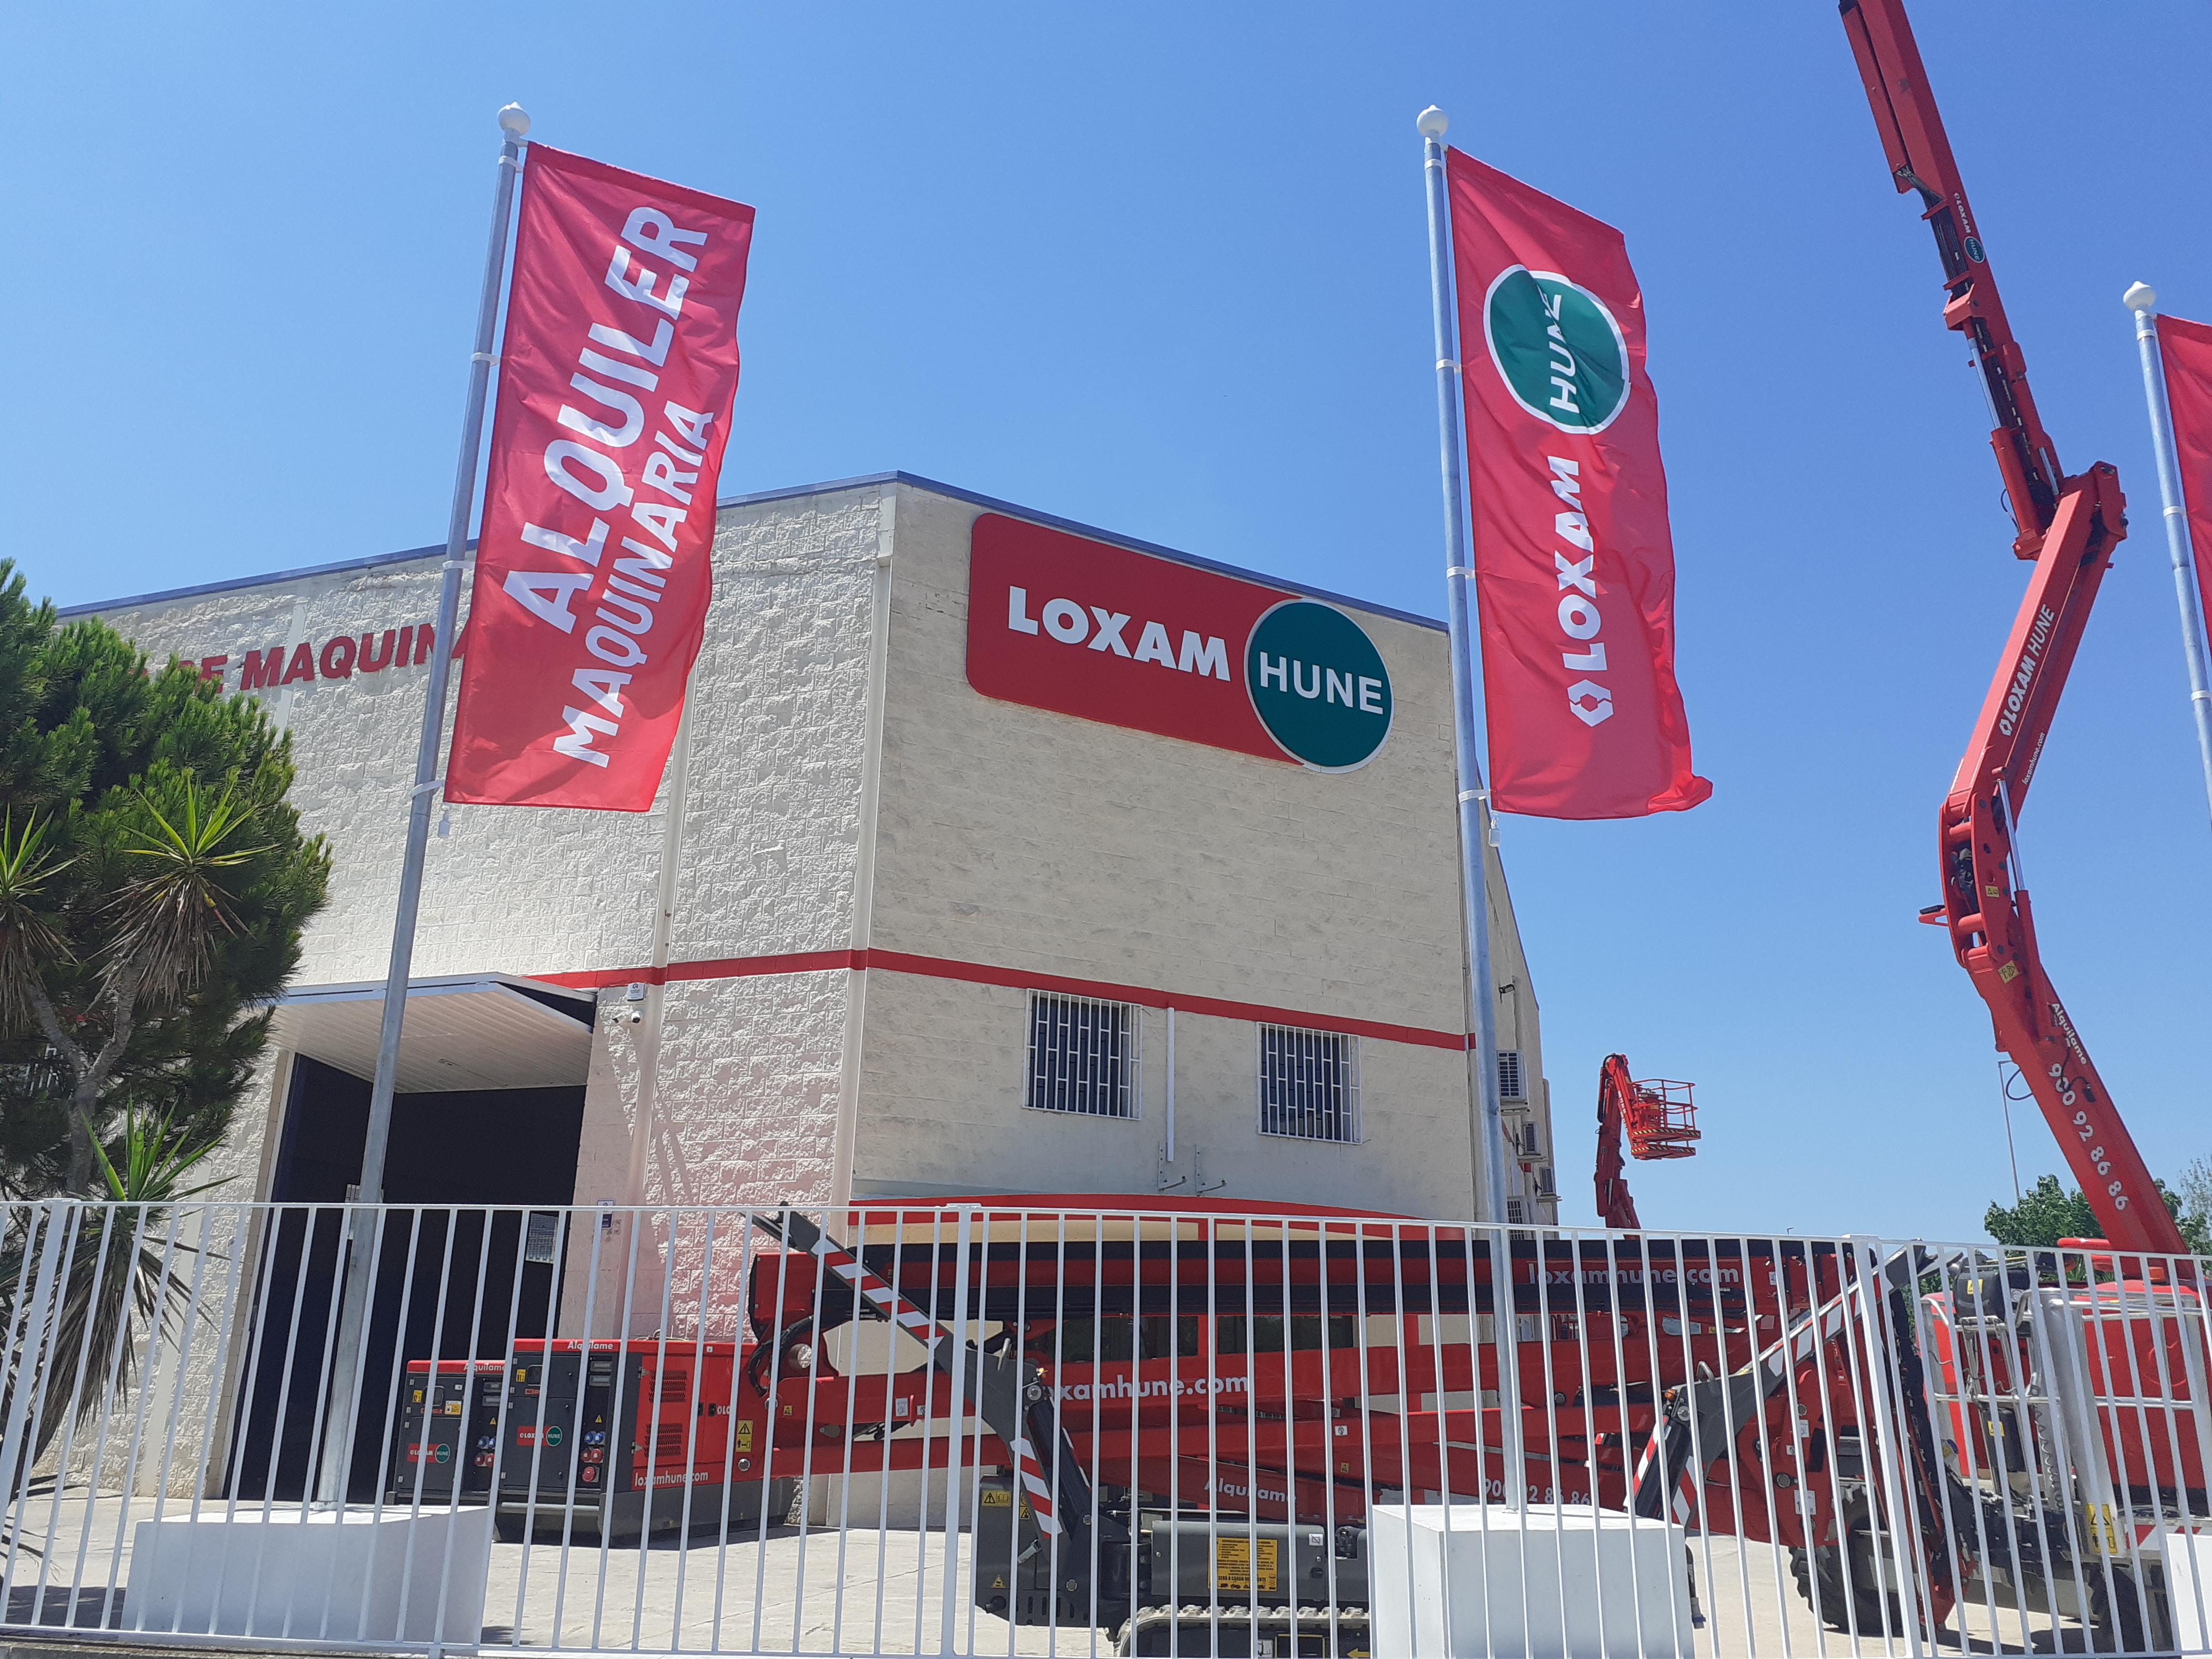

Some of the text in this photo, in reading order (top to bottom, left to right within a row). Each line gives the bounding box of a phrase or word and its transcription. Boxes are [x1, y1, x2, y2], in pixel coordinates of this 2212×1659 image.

[1956, 200, 1971, 233] LOXAM
[503, 206, 708, 635] ALQUILER
[552, 400, 714, 768] MAQUINARIA
[1548, 455, 1608, 671] LOXAM
[1008, 585, 1384, 715] LOXAM HUNE
[2003, 603, 2054, 724] LOXAM HUNE
[2021, 732, 2045, 786] loxamhune.com
[2051, 1003, 2087, 1065] Alquilame
[2049, 1063, 2129, 1210] 900 92 86 86
[567, 1341, 614, 1350] Alqilame
